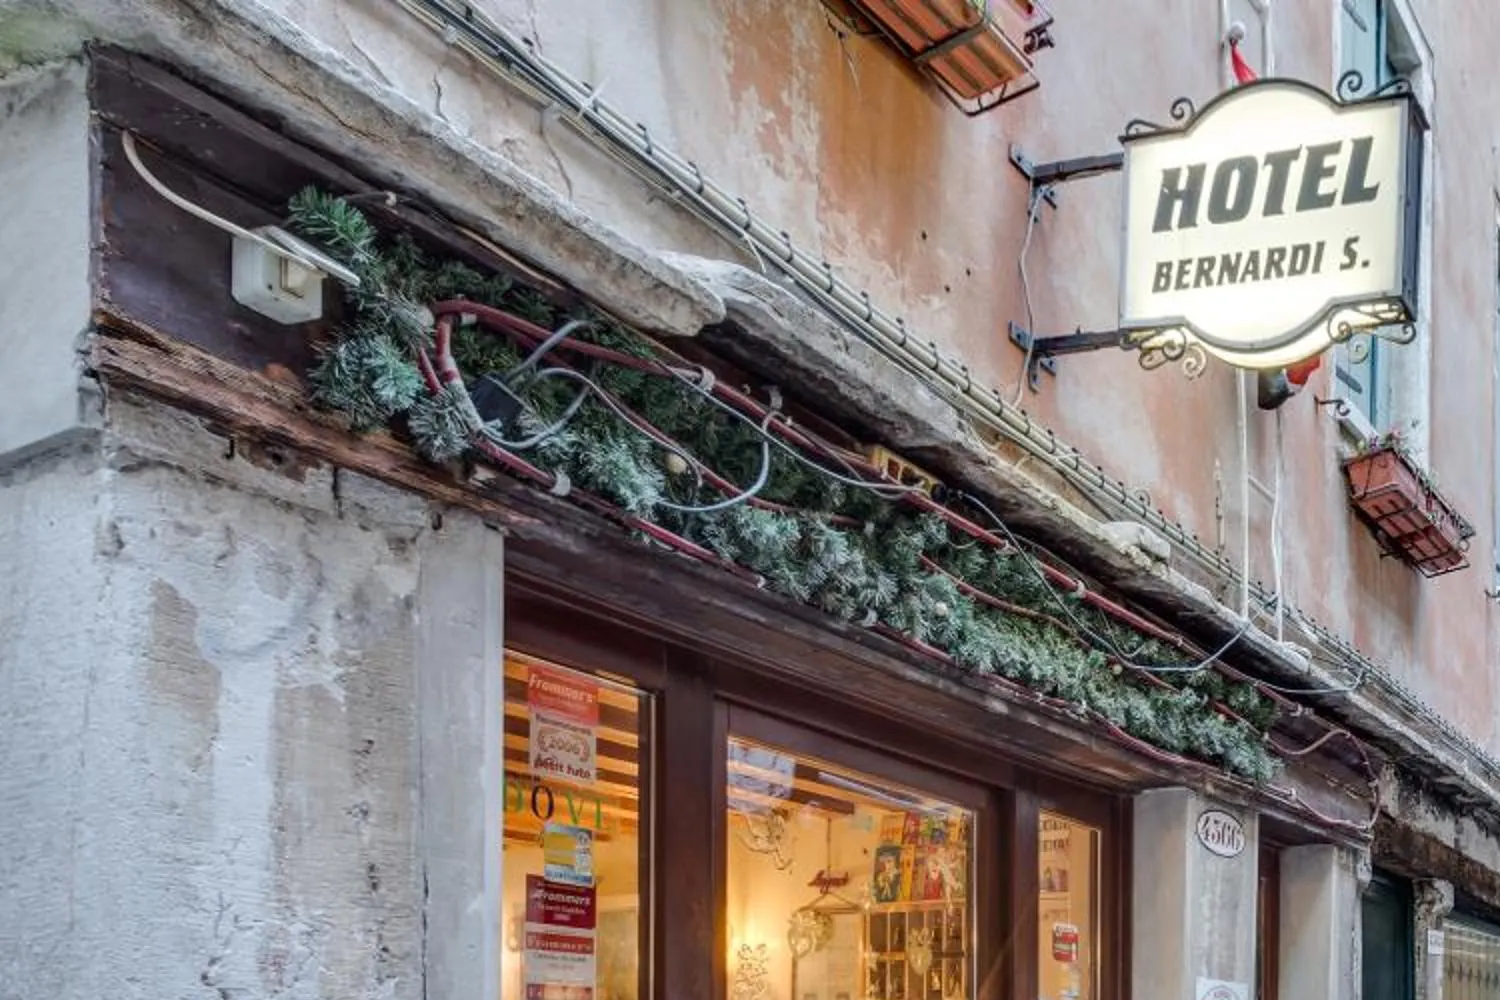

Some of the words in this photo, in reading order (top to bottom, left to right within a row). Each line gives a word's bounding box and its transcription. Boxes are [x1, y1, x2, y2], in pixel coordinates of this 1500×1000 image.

[1152, 136, 1380, 233] HOTEL
[1152, 240, 1326, 293] BERNARDI
[1340, 236, 1370, 271] S.
